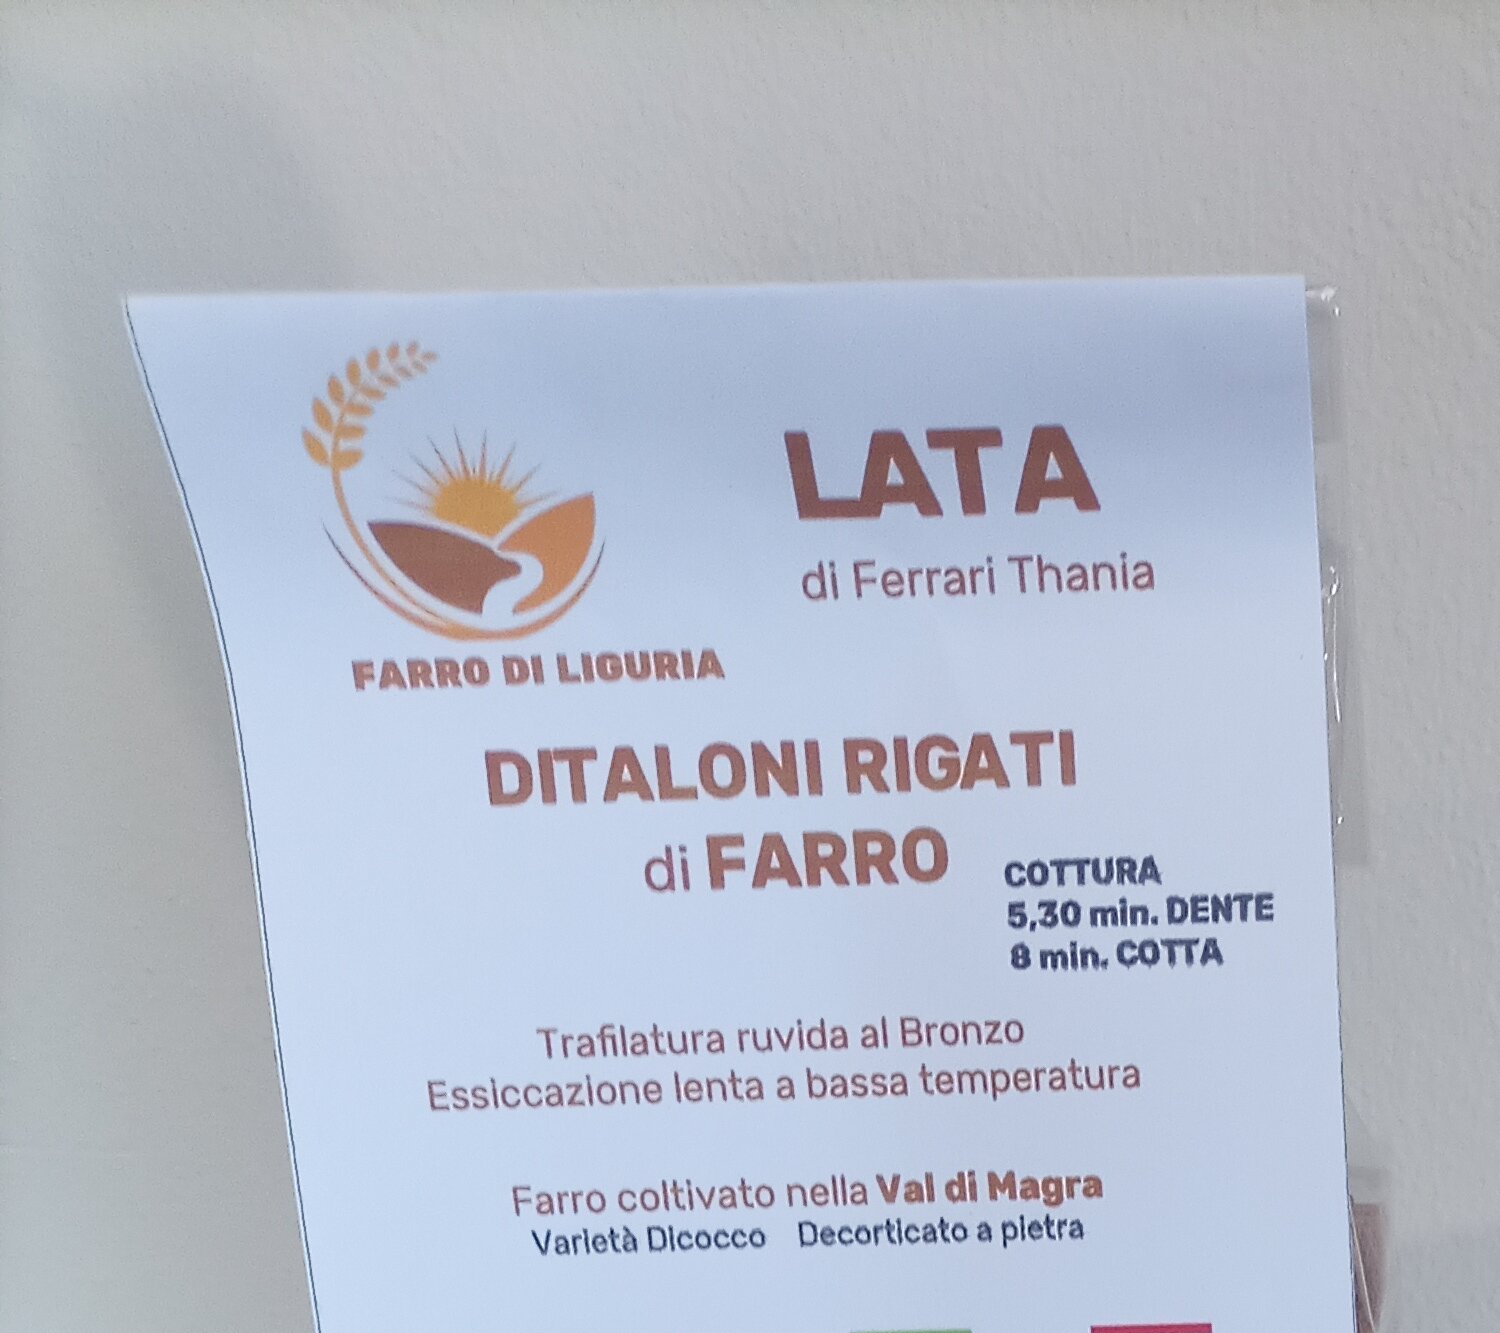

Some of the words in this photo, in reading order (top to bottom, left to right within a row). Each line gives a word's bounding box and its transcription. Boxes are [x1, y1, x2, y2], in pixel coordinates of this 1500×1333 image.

[784, 423, 1101, 520] LATA
[802, 560, 839, 601] di
[853, 556, 995, 599] Ferrari
[1007, 552, 1154, 594] Thania
[352, 656, 490, 691] FARRO
[502, 655, 544, 685] DI
[556, 648, 725, 683] LIGURIA
[485, 739, 823, 806] DITALONI
[843, 729, 1076, 795] RIGATI
[645, 844, 690, 893] di
[706, 826, 948, 890] FARRO
[1004, 854, 1162, 889] COTTURA
[1008, 898, 1081, 932] 5,30
[1090, 896, 1158, 928] min.
[1166, 892, 1274, 925] DENTE
[1011, 941, 1031, 970] 8
[1040, 940, 1109, 972] min.
[1116, 937, 1224, 969] COTTA
[536, 1023, 725, 1059] Trafilatura
[738, 1018, 848, 1053] ruvida
[861, 1016, 888, 1049] al
[900, 1016, 1024, 1047] Bronzo
[427, 1074, 662, 1111] Essiccazione
[674, 1069, 764, 1103] lenta
[777, 1076, 795, 1100] a
[806, 1067, 908, 1099] bassa
[919, 1058, 1140, 1102] temperatura
[512, 1186, 606, 1216] Farro
[618, 1177, 775, 1213] coltivato
[787, 1174, 868, 1207] nella
[876, 1172, 935, 1204] Val
[945, 1170, 977, 1203] di
[987, 1170, 1103, 1208] Magra
[531, 1225, 638, 1256] Varietà
[647, 1225, 767, 1253] Dicocco
[798, 1217, 970, 1248] Decorticato
[977, 1221, 992, 1243] a
[1001, 1213, 1085, 1249] pietra
